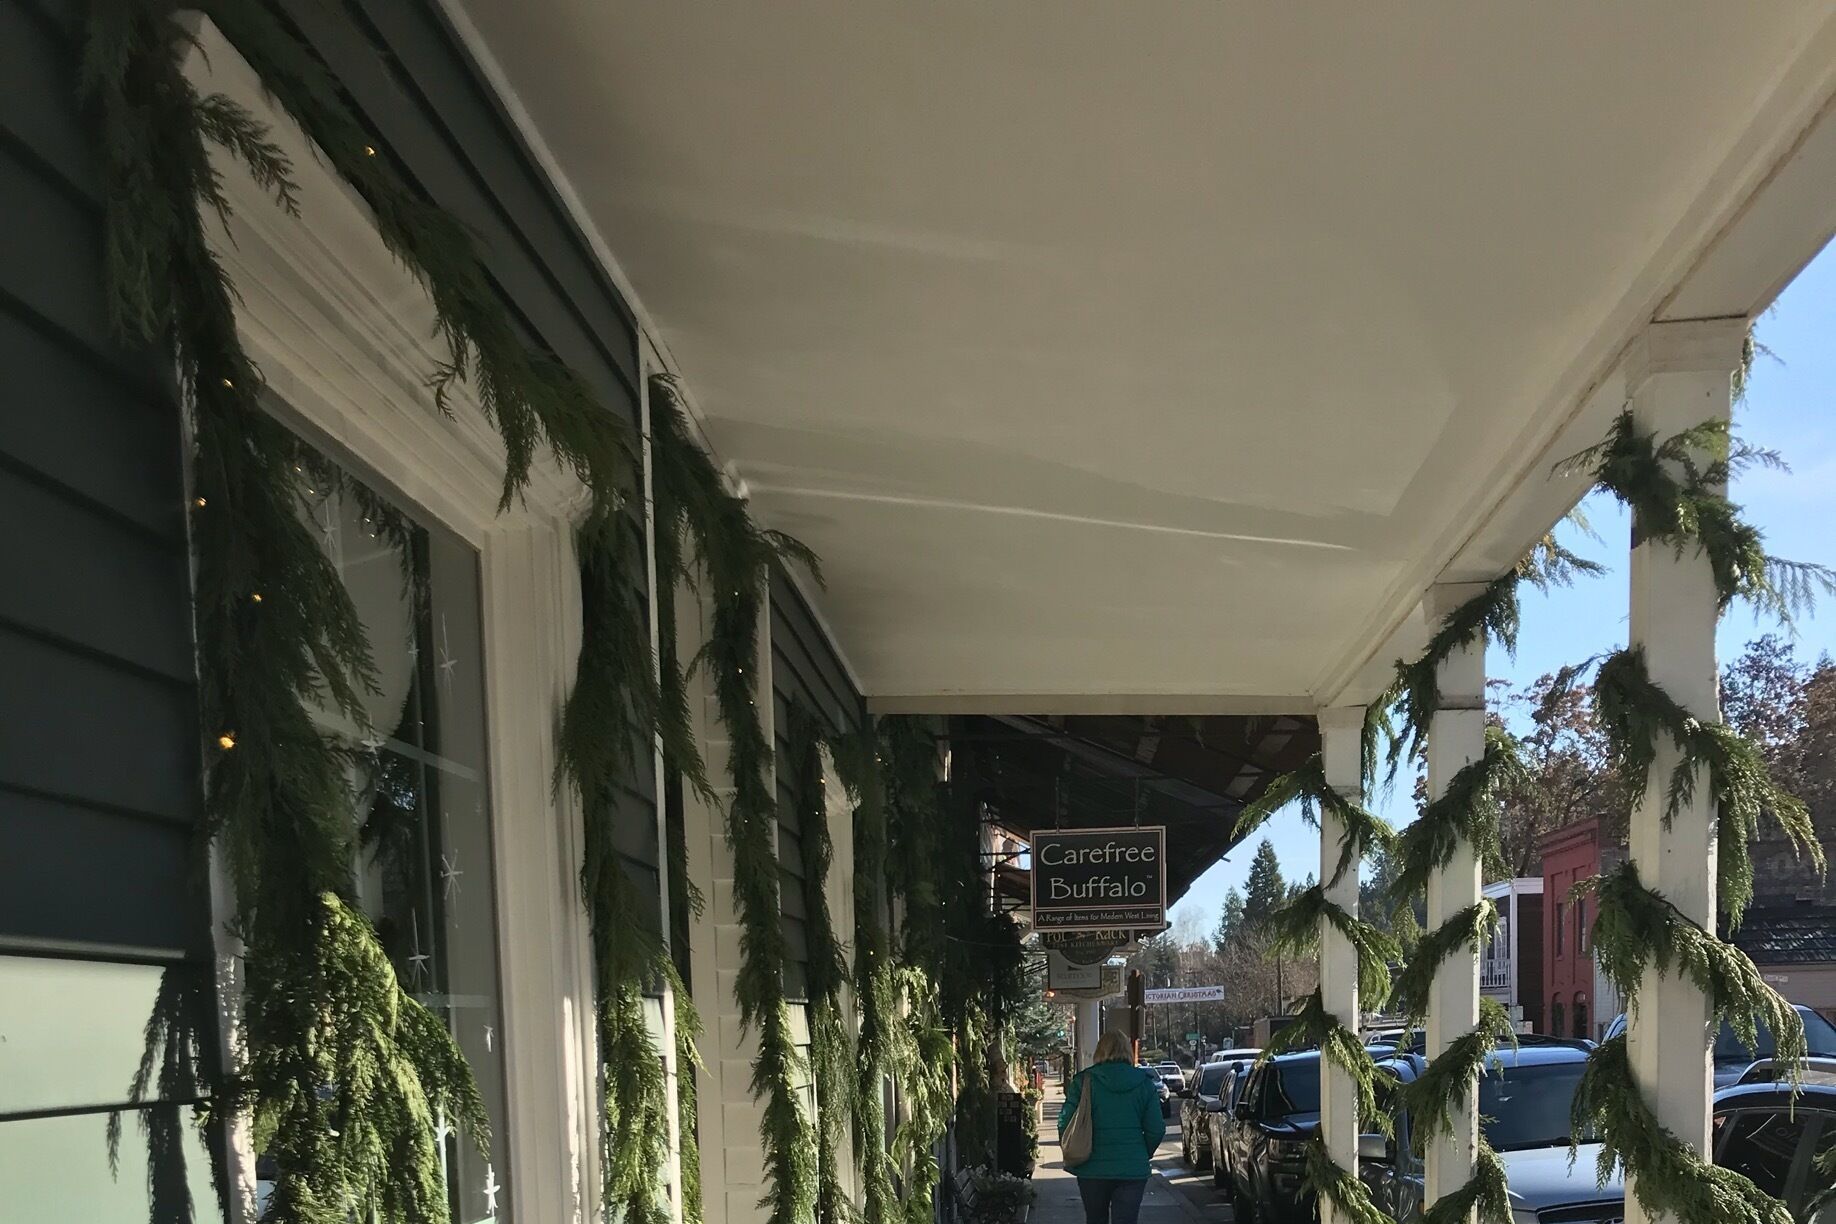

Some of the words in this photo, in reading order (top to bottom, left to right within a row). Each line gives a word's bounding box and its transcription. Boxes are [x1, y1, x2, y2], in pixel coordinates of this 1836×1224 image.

[1040, 841, 1155, 866] Carefree
[1050, 875, 1146, 900] Buffalo
[1038, 914, 1045, 922] A
[1047, 914, 1064, 925] Range
[1065, 912, 1073, 921] of
[1074, 912, 1089, 921] Items
[1090, 912, 1099, 921] for
[1124, 911, 1140, 919] West
[1145, 991, 1177, 1000] ICTORIAN
